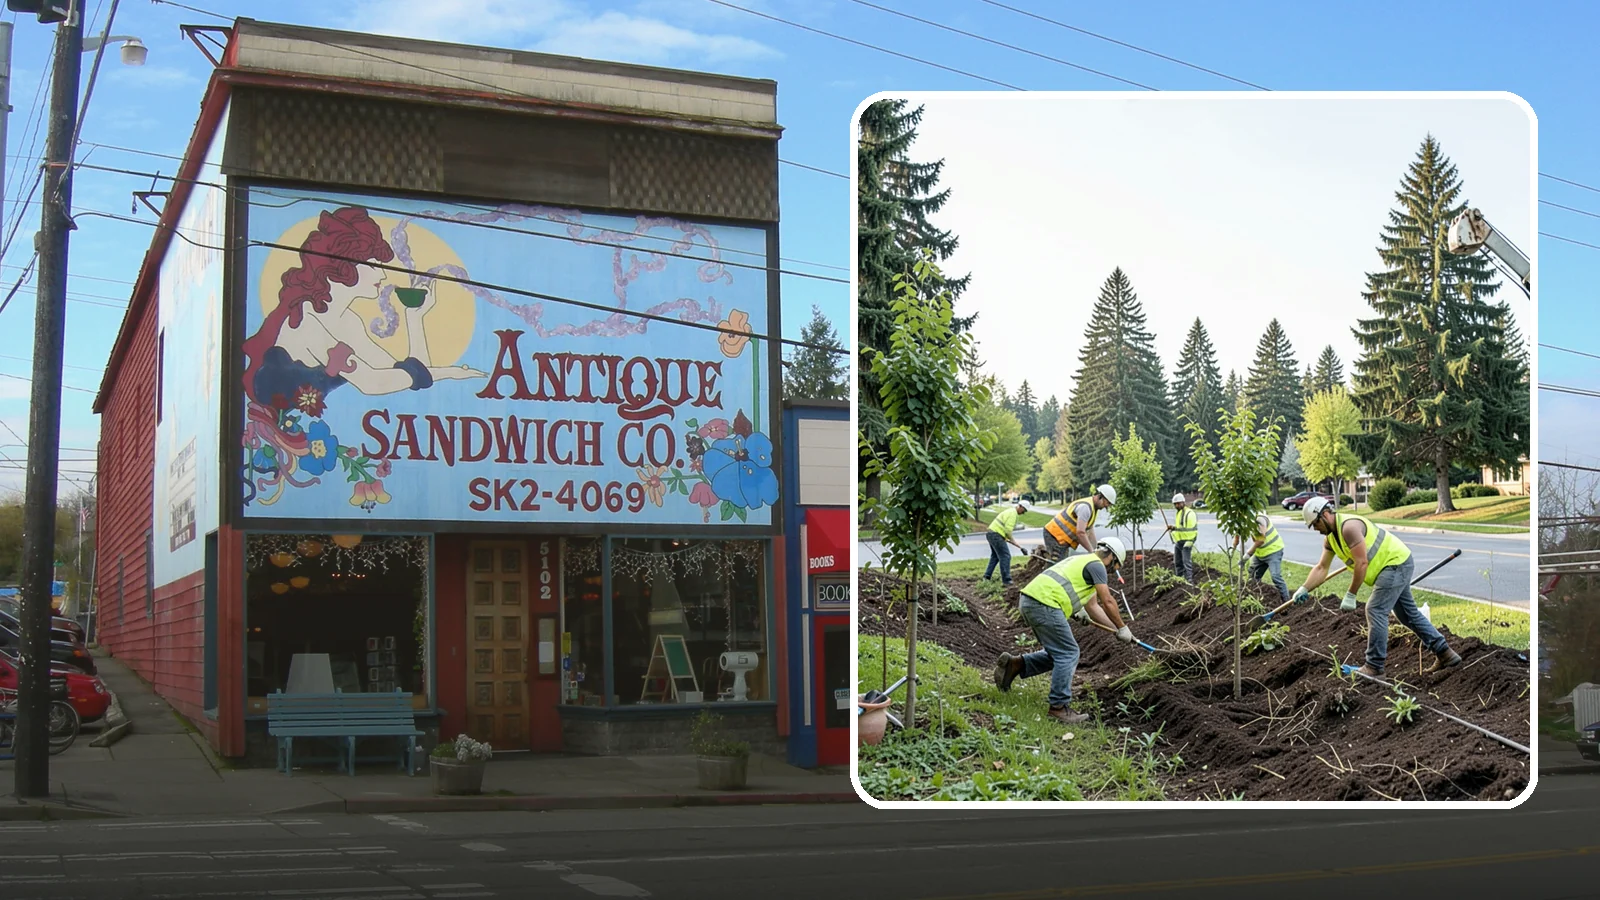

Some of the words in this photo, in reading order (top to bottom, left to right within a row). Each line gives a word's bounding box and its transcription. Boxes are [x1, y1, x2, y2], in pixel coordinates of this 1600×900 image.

[475, 329, 723, 420] ANTIQUE
[361, 409, 604, 467] SANDWICH
[617, 427, 686, 469] CO.
[468, 477, 646, 513] SK2-4069
[540, 541, 552, 600] 5102
[809, 556, 835, 569] BOOKS
